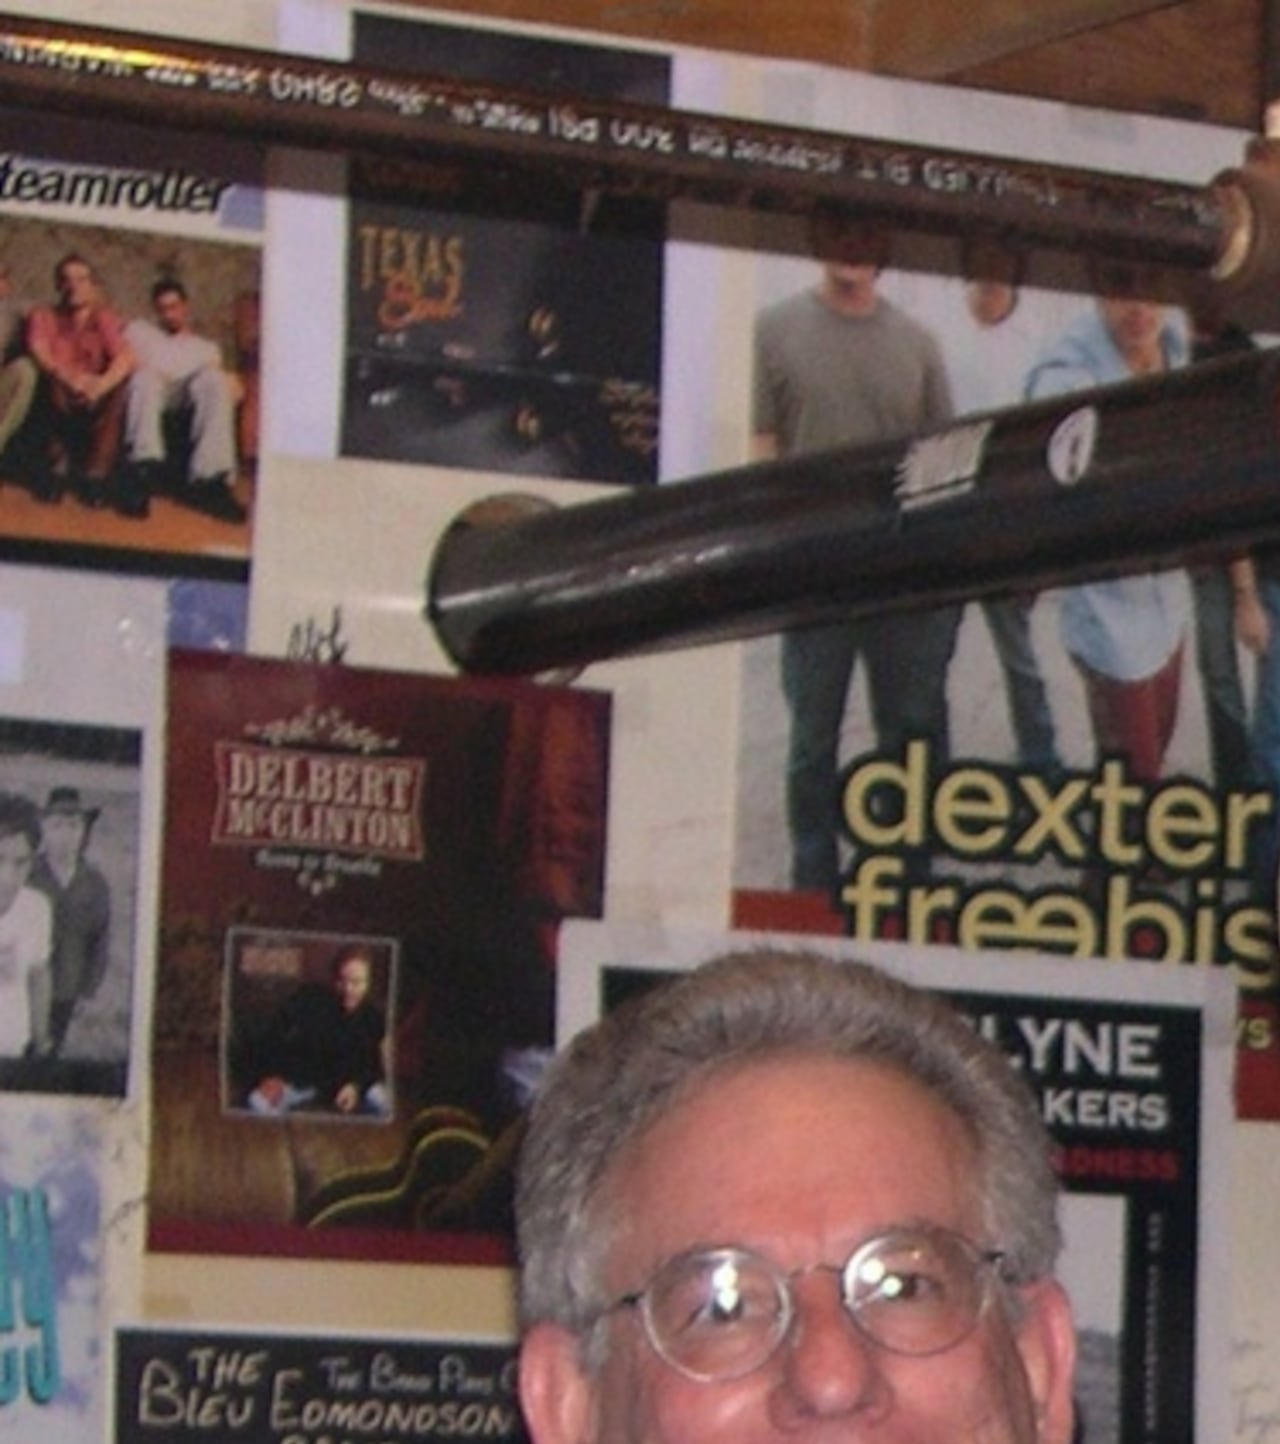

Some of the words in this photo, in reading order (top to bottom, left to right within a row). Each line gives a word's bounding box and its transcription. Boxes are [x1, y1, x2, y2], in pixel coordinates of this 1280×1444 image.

[0, 155, 231, 212] teamroller
[228, 752, 412, 811] DELBERT
[842, 740, 1272, 870] dexter
[842, 856, 1279, 990] freebis
[1043, 1089, 1170, 1132] KERS
[189, 1346, 269, 1388] THE
